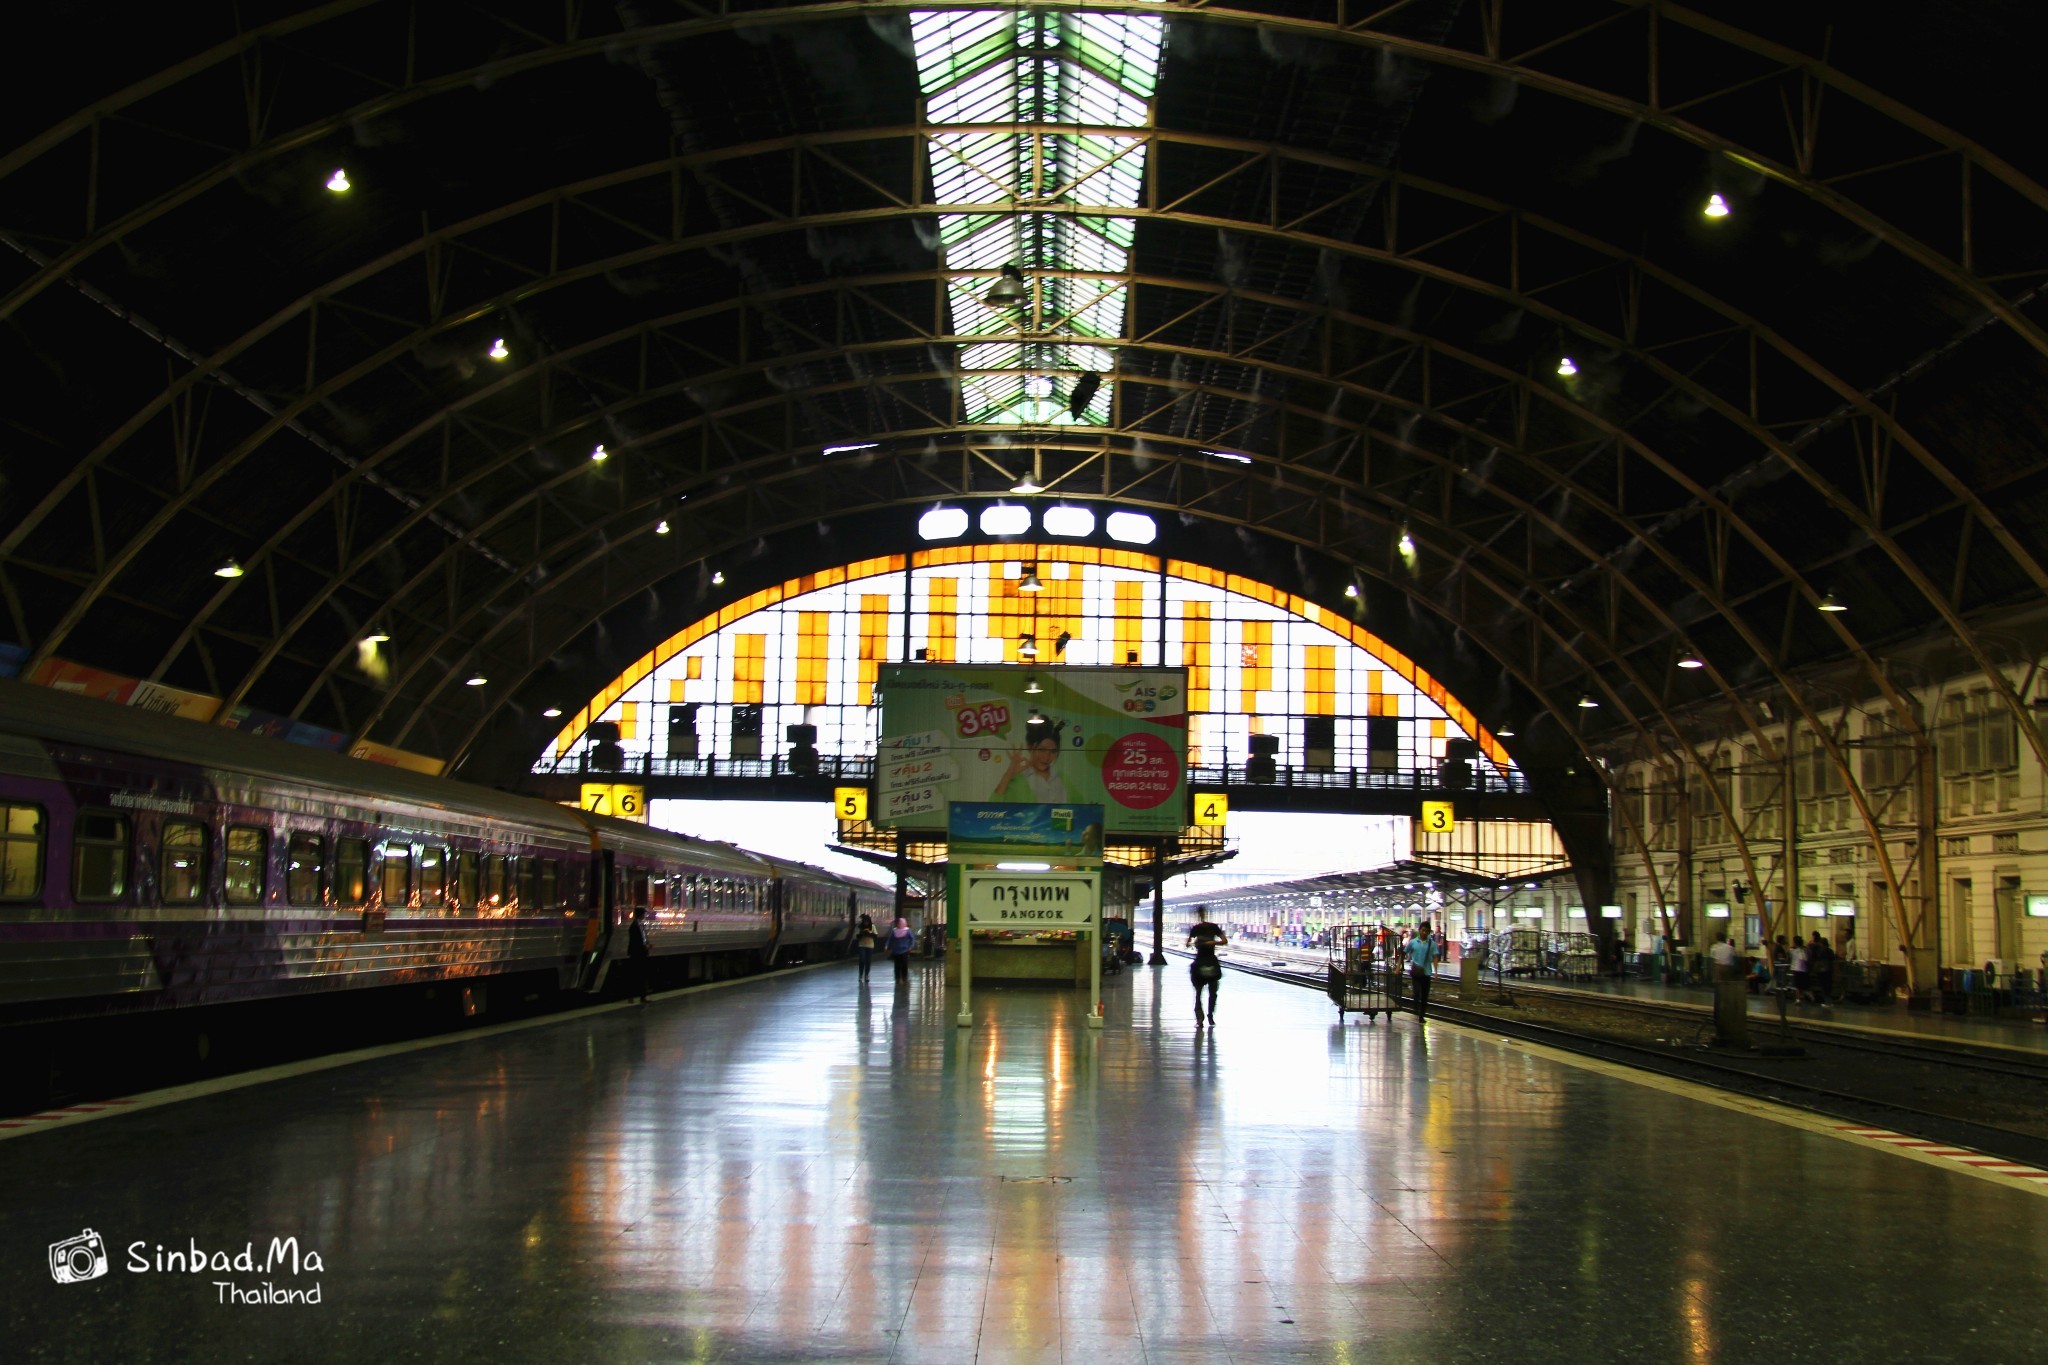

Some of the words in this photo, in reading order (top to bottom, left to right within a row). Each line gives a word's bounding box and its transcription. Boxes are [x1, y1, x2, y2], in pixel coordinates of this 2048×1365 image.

[1135, 687, 1157, 697] AIS
[1122, 748, 1148, 765] 25
[923, 761, 933, 772] 2
[1112, 766, 1169, 781] ทุกเครือข่าย
[1138, 781, 1152, 791] 24
[590, 794, 605, 812] 7
[622, 794, 636, 812] 6
[844, 797, 857, 815] 5
[901, 790, 921, 807] คุ้ม
[923, 789, 932, 800] 3
[1203, 803, 1219, 820] 4
[1432, 810, 1446, 829] 3
[992, 885, 1070, 907] กรุงเทพ
[1001, 910, 1064, 919] BANGKOK
